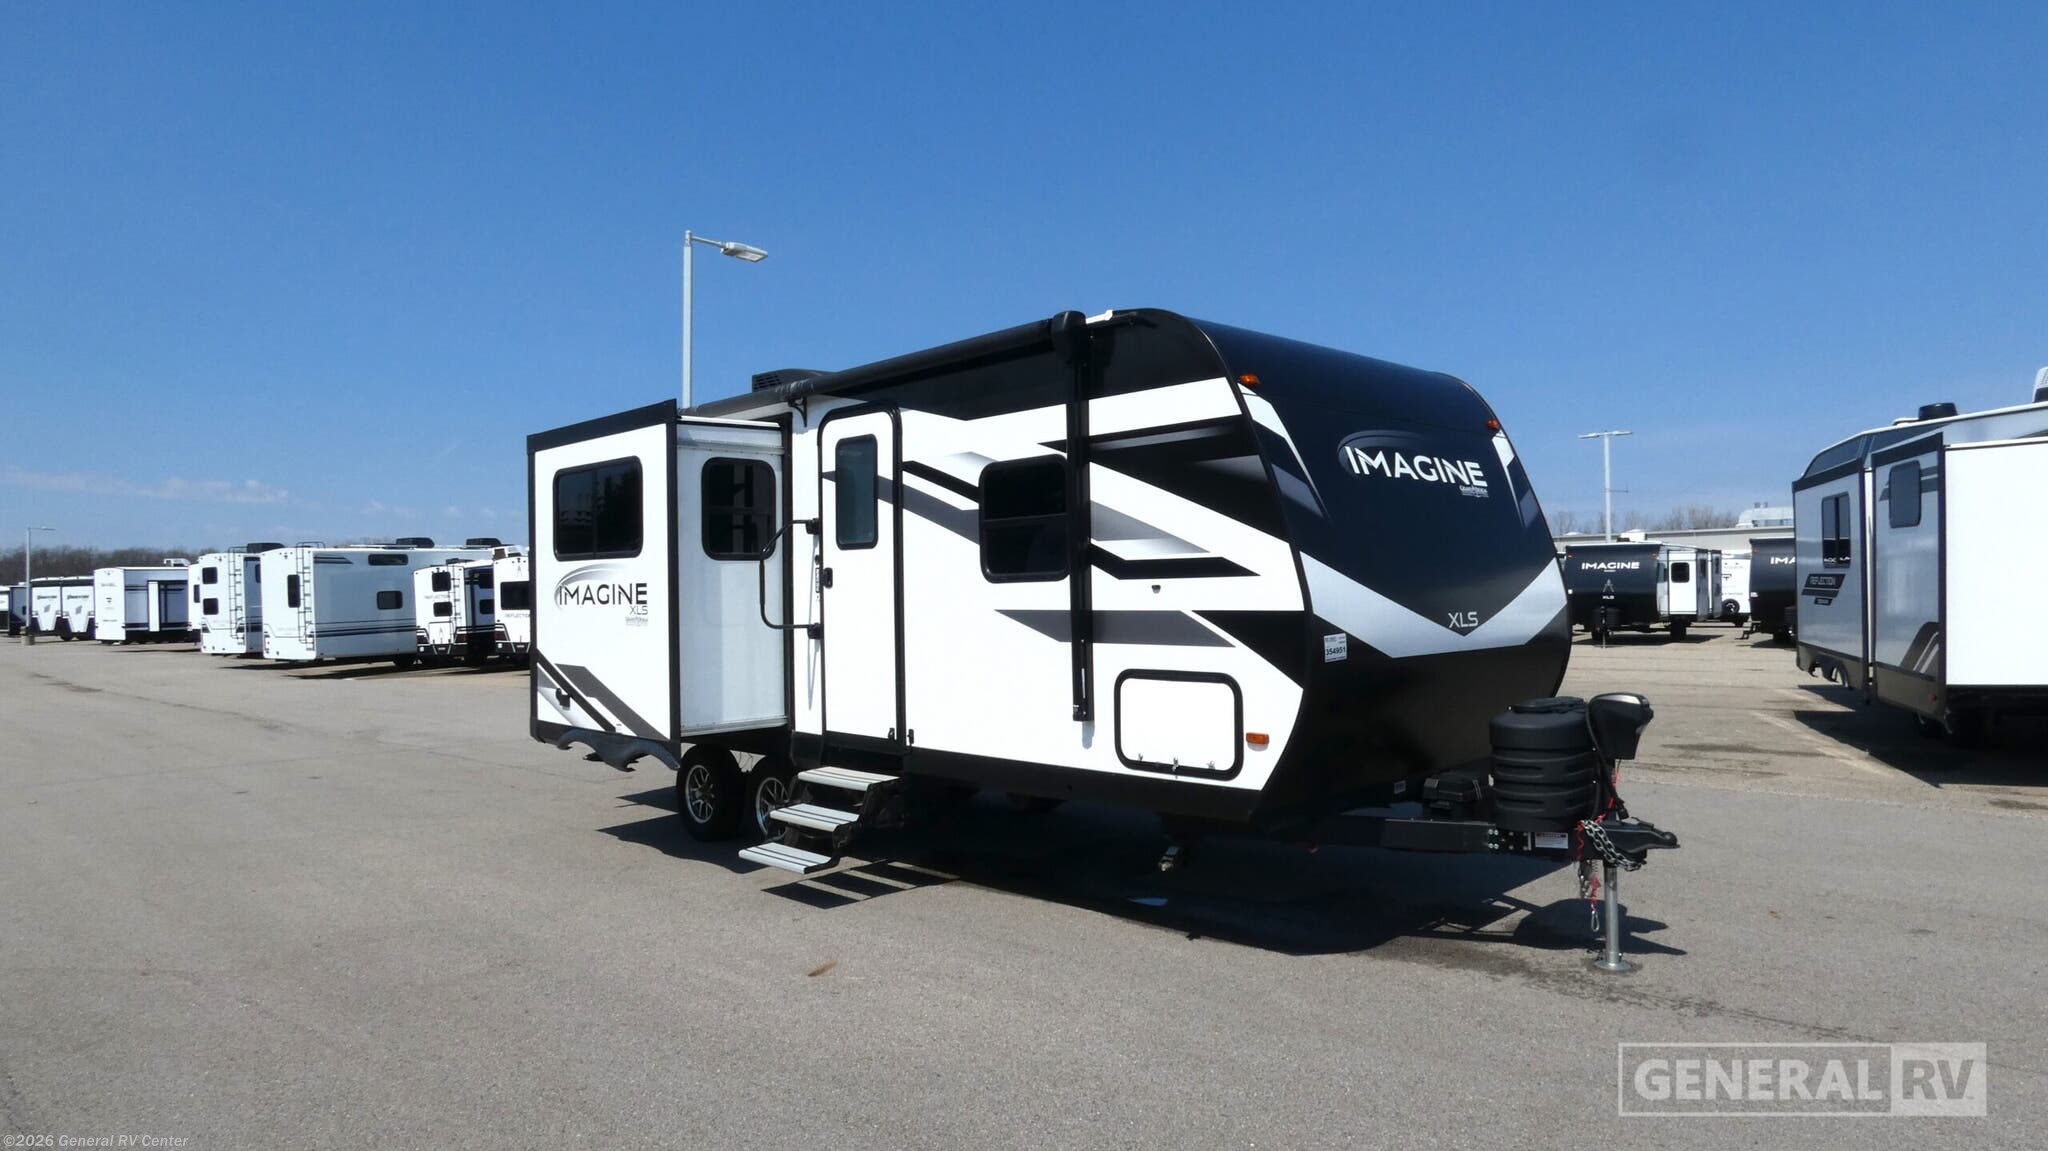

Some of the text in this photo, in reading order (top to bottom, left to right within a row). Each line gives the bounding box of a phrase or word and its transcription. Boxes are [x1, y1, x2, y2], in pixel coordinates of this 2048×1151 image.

[1344, 446, 1488, 487] IMAGINE
[1581, 561, 1640, 570] IMAGINE
[559, 583, 648, 605] IMAGINE
[629, 605, 648, 616] XLS
[1448, 611, 1479, 629] XLS
[1325, 646, 1346, 655] 354951
